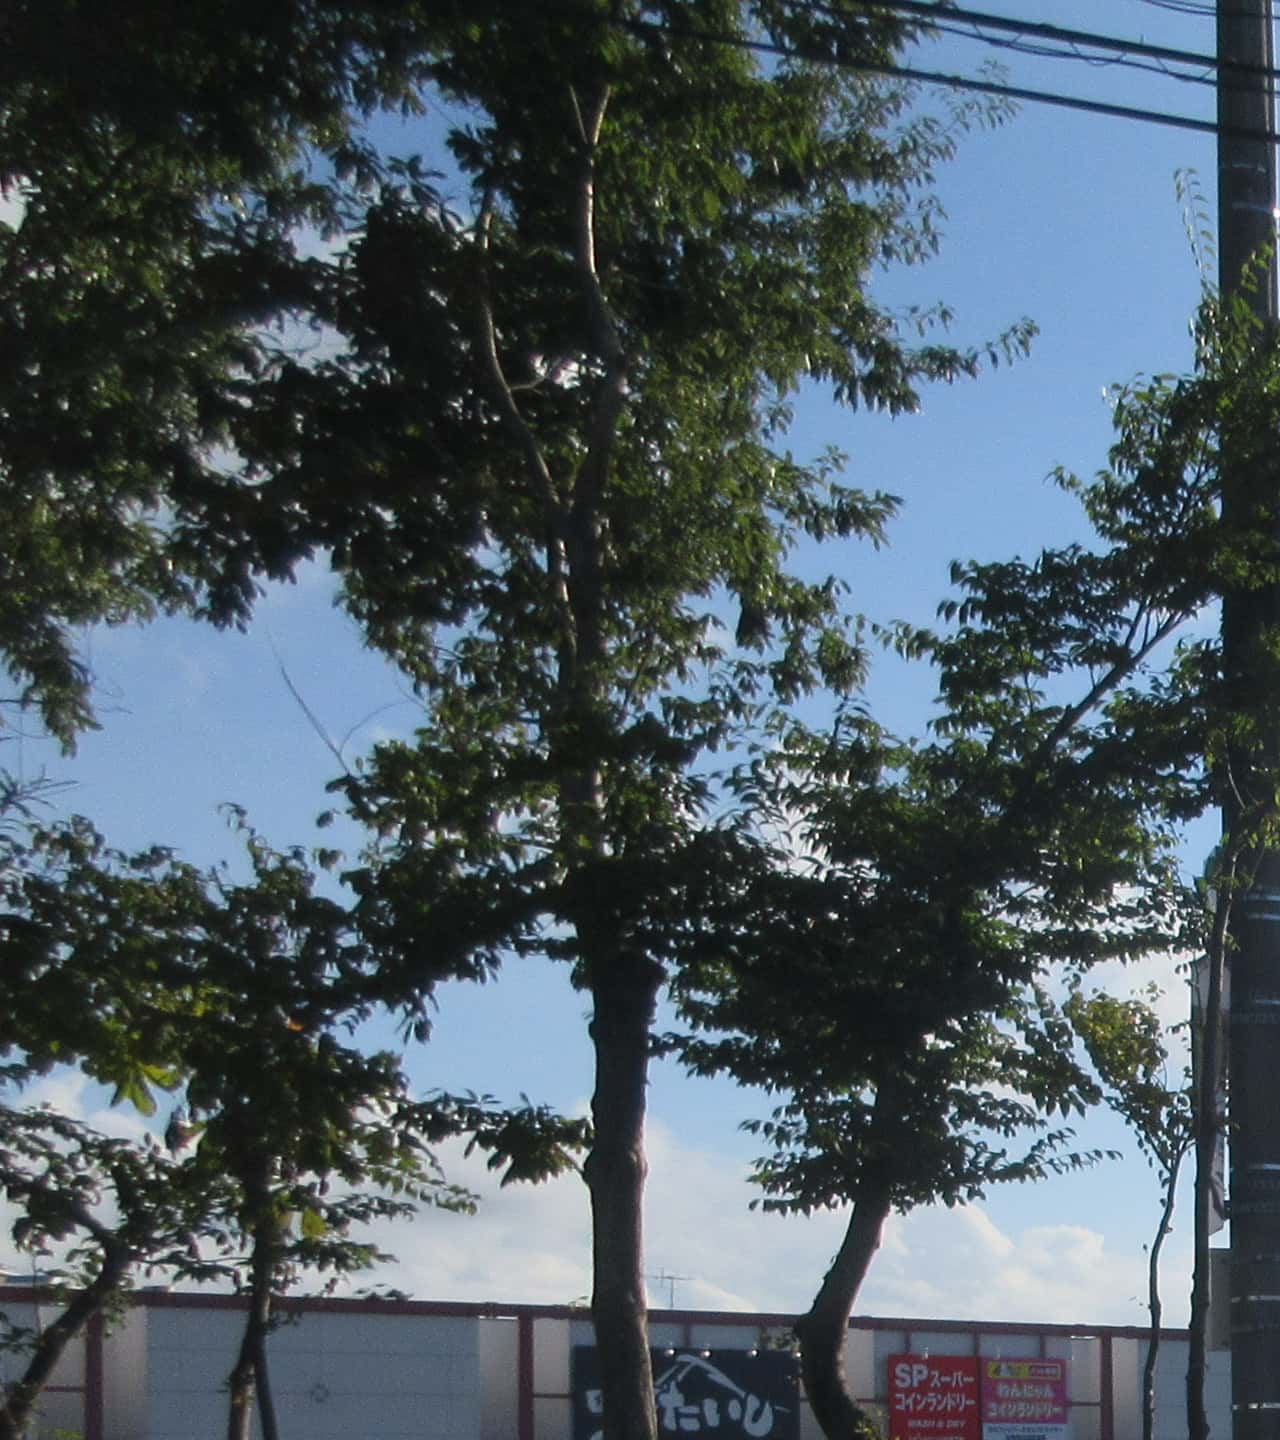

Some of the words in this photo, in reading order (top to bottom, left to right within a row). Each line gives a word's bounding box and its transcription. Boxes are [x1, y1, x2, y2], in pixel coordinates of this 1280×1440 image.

[895, 1363, 928, 1388] SP
[931, 1370, 976, 1388] スーパー
[895, 1393, 976, 1412] コインランドリー
